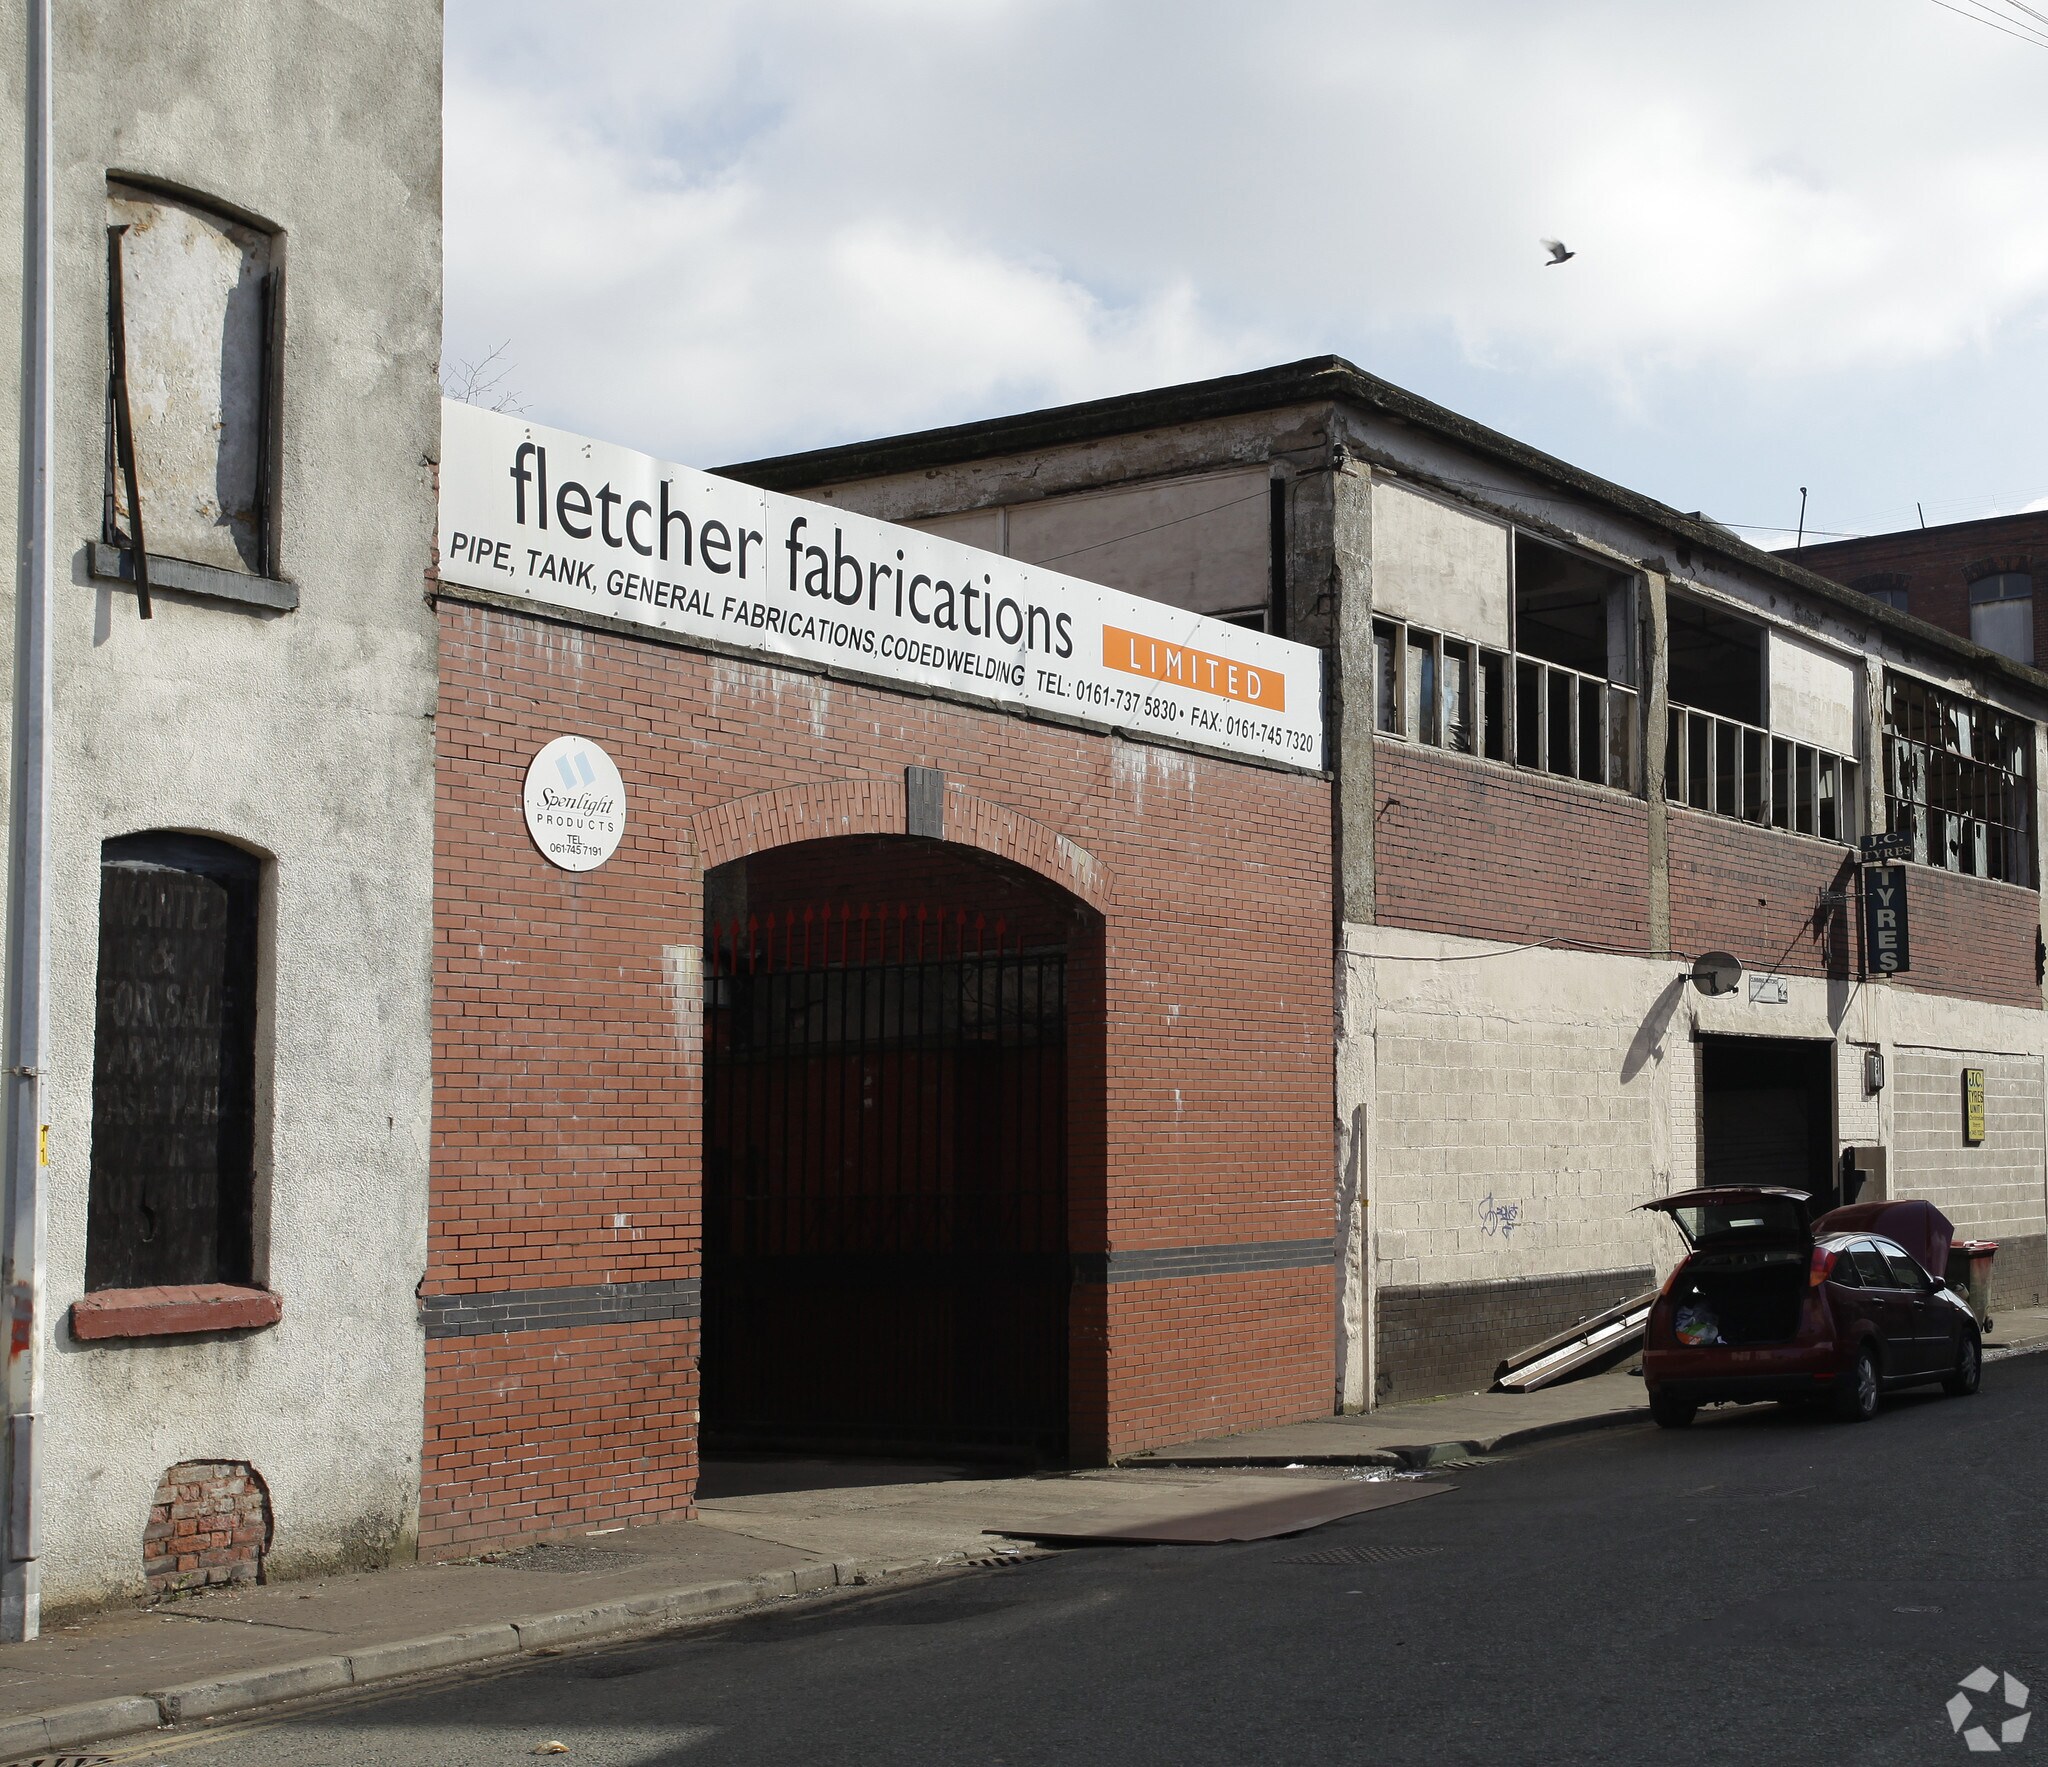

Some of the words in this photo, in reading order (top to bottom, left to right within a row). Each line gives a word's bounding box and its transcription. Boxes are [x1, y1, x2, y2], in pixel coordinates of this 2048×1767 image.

[510, 442, 764, 580] fletcher
[785, 516, 1074, 660] fabrications
[450, 532, 515, 577] PIPE,
[527, 549, 598, 595] TANK,
[607, 570, 715, 618] GENERAL
[1037, 669, 1071, 698] TEL:
[1076, 680, 1141, 713] 0161-737
[1191, 706, 1222, 732] FAX:
[1226, 715, 1282, 746] 0161-745
[1286, 729, 1313, 753] 7320
[1129, 638, 1263, 701] LIMITED
[536, 787, 614, 818] Spenlight
[536, 813, 615, 832] PRODUCTS
[1869, 833, 1904, 848] J.C.
[583, 845, 602, 857] 7191
[1862, 845, 1912, 860] TYRES
[1875, 867, 1899, 971] TYRES
[1969, 1072, 1982, 1087] J.C.
[1968, 1090, 1984, 1104] TYRES
